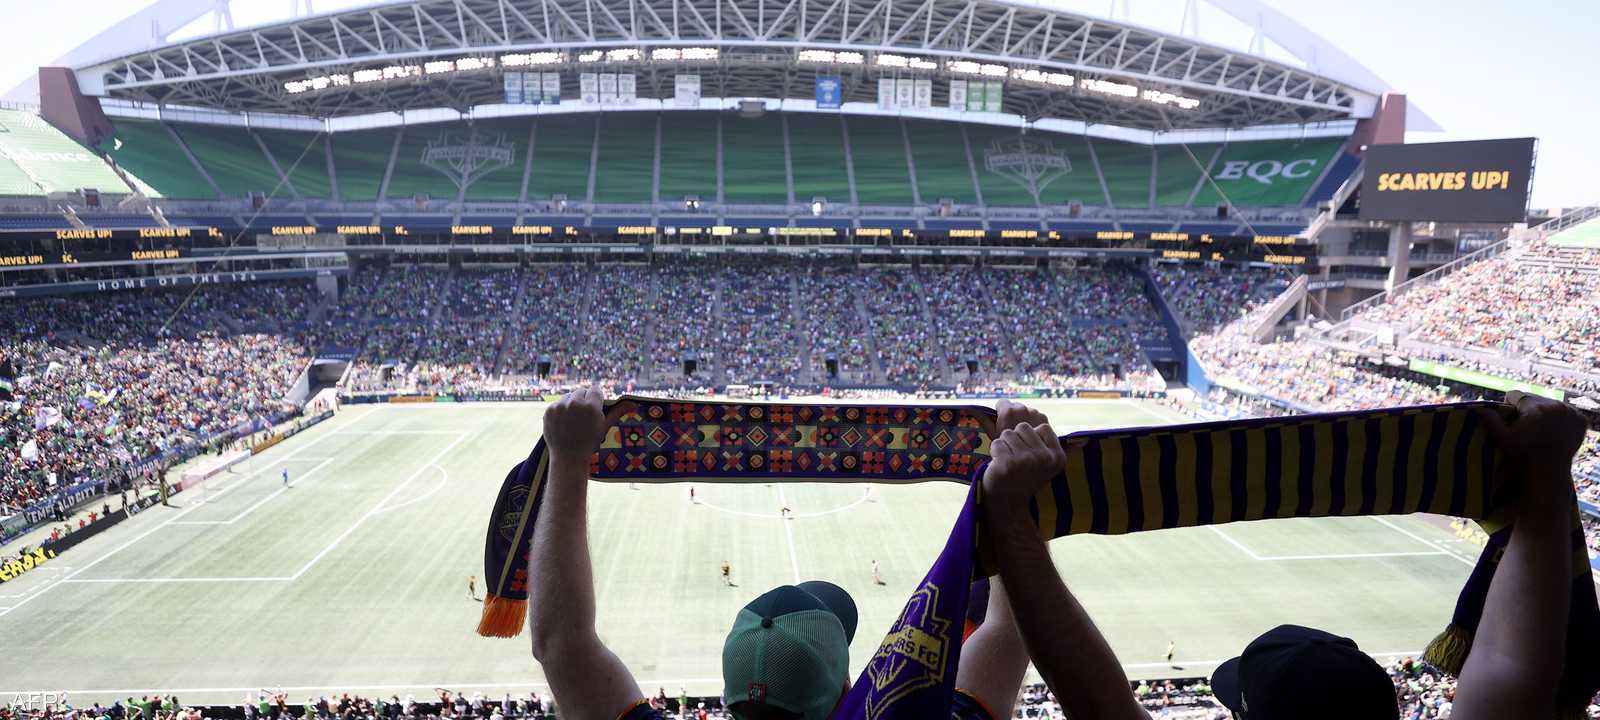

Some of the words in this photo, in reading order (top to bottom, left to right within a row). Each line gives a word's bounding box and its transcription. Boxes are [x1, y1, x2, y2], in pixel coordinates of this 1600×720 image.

[1214, 159, 1317, 184] EQC
[1377, 171, 1467, 192] SCARVES
[1471, 170, 1510, 190] UP!
[56, 229, 95, 239] SCARVES
[97, 229, 112, 239] UP!
[139, 227, 175, 237] SCARVES
[176, 227, 191, 237] UP!
[271, 226, 302, 235] SCARVES
[304, 226, 316, 235] UP!
[336, 226, 367, 235] SCARVES
[368, 226, 381, 235] UP!
[451, 226, 479, 235] SCARVES
[28, 255, 44, 264] UP!
[131, 250, 163, 260] SCARVES
[163, 250, 179, 260] UP!
[98, 279, 147, 290] HOME
[158, 276, 178, 286] OF
[192, 274, 220, 284] THE
[919, 645, 938, 666] FC
